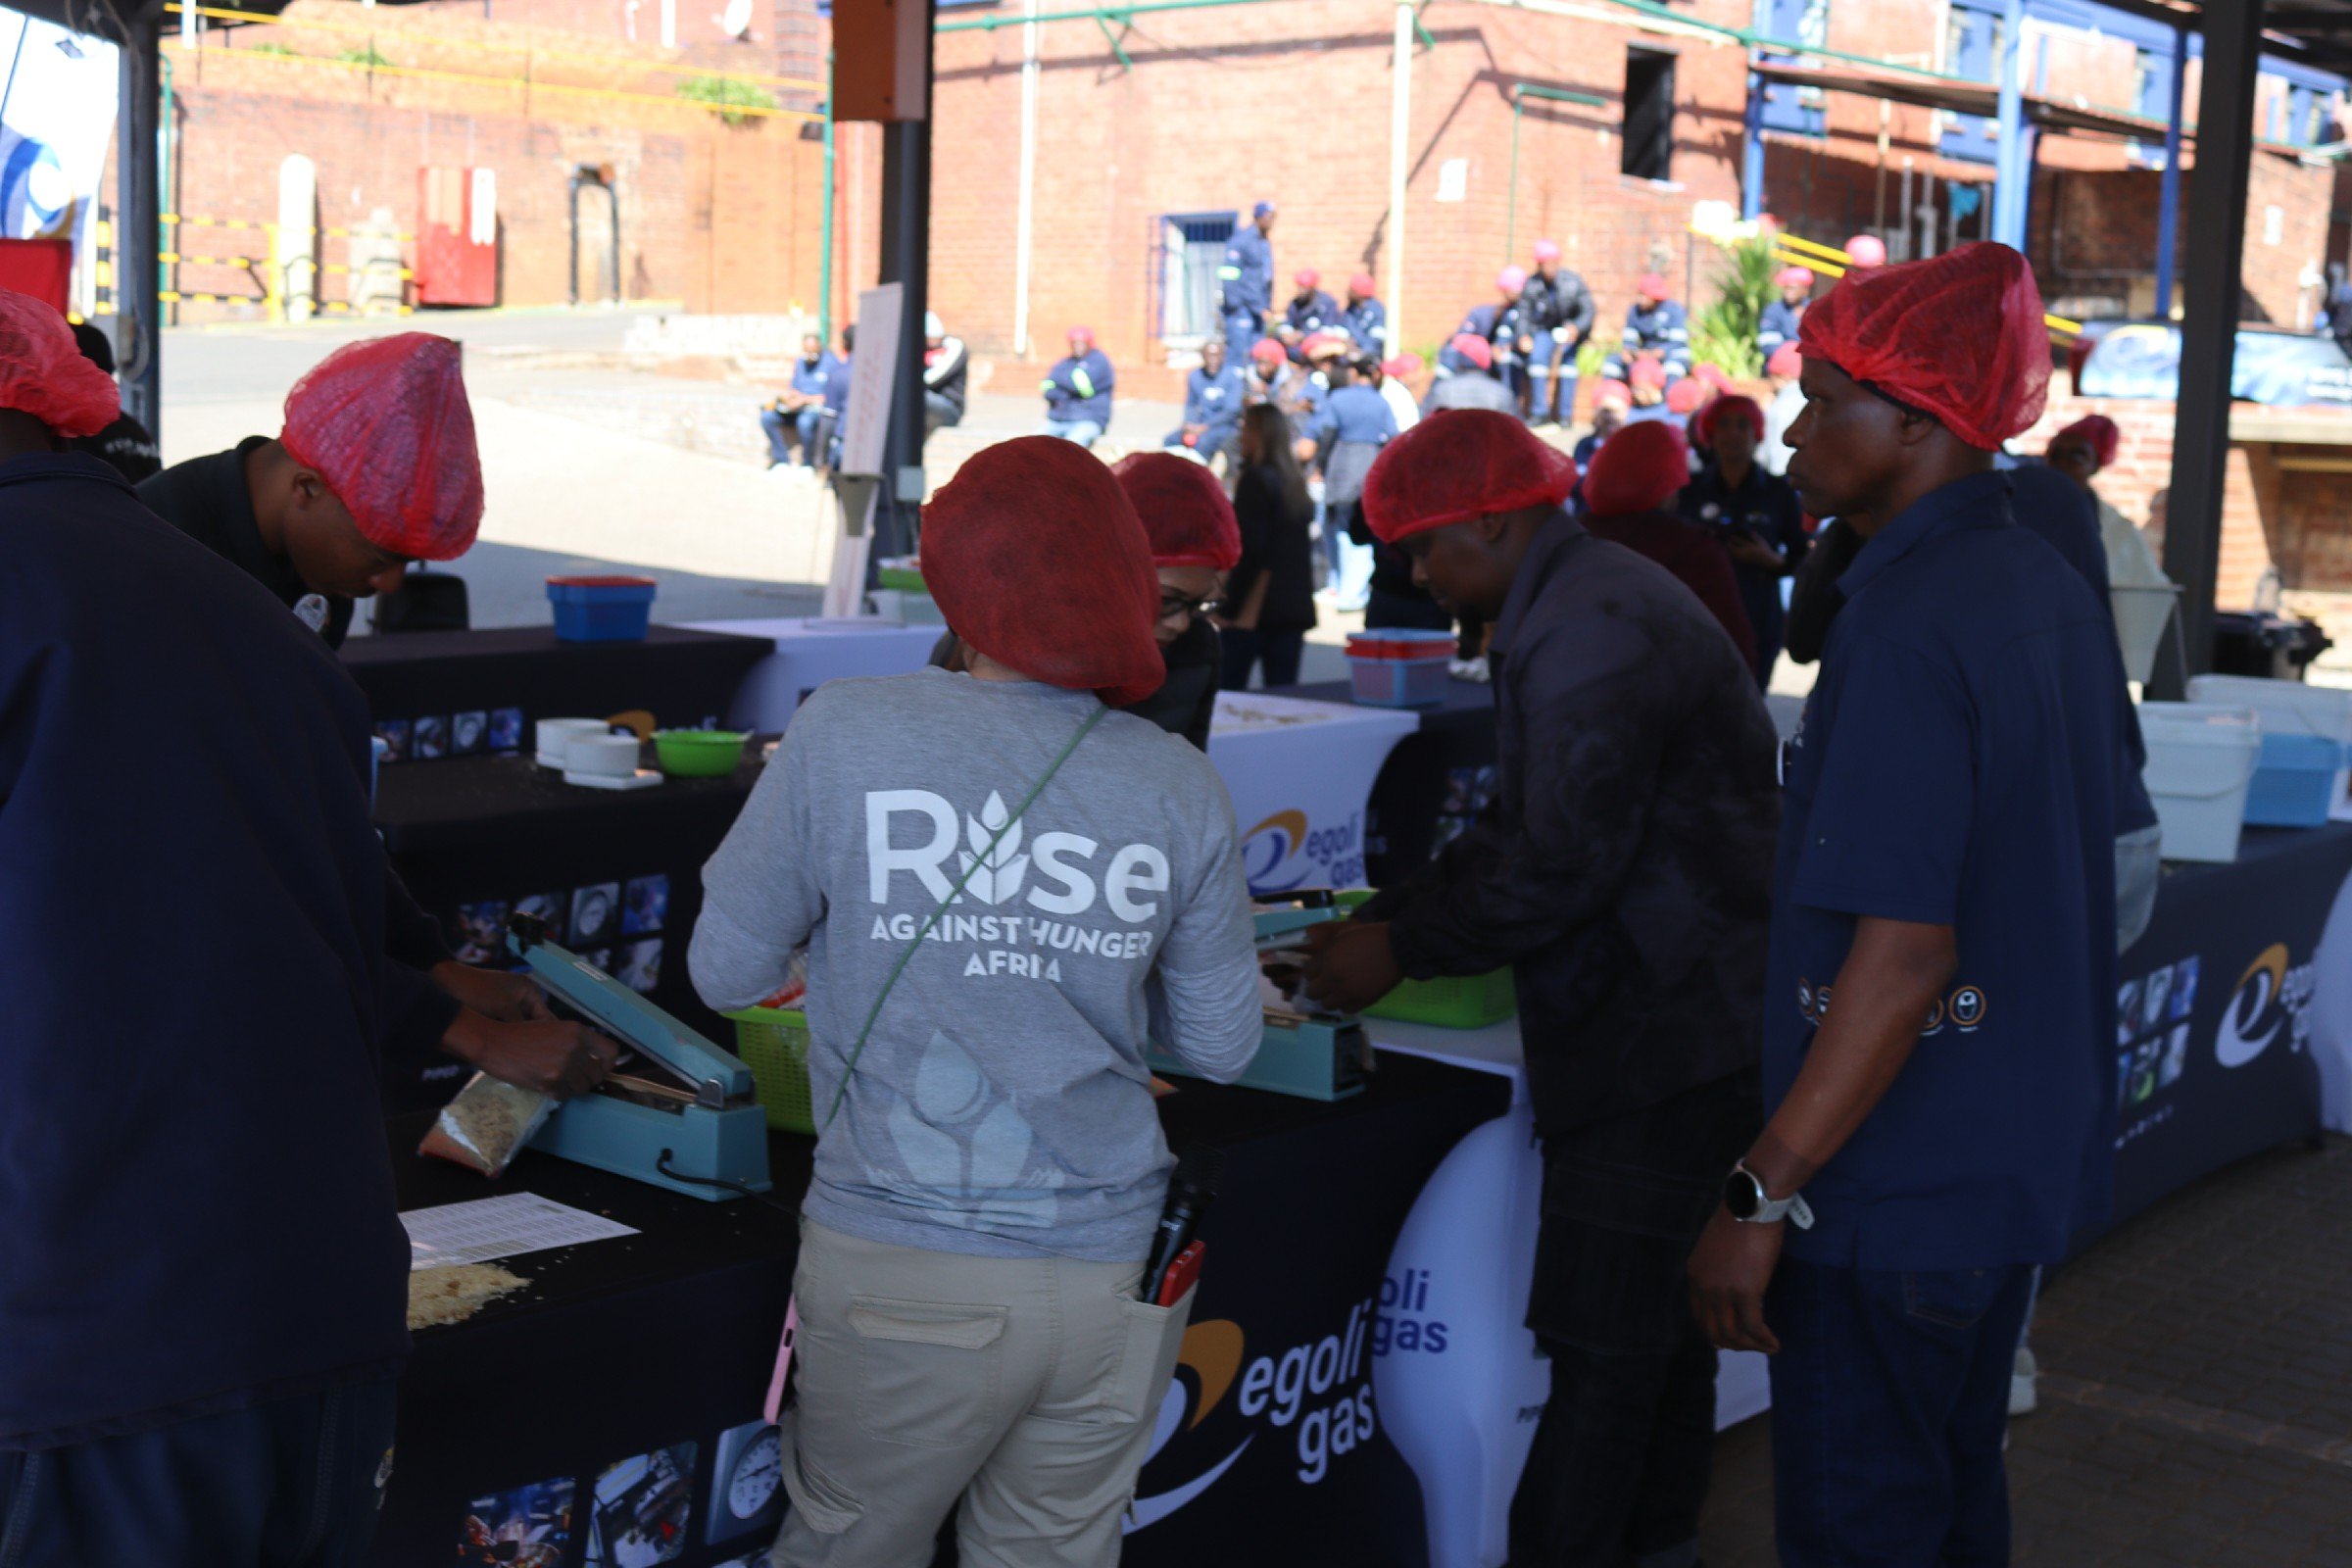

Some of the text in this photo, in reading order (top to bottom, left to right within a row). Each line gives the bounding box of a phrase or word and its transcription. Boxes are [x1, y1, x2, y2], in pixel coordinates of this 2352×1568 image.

[870, 914, 1152, 959] AGAINST HUNGER
[963, 951, 1061, 983] AFRIA
[1372, 1315, 1448, 1357] gas
[1239, 1298, 1372, 1427] egoli
[1298, 1384, 1374, 1485] gas
